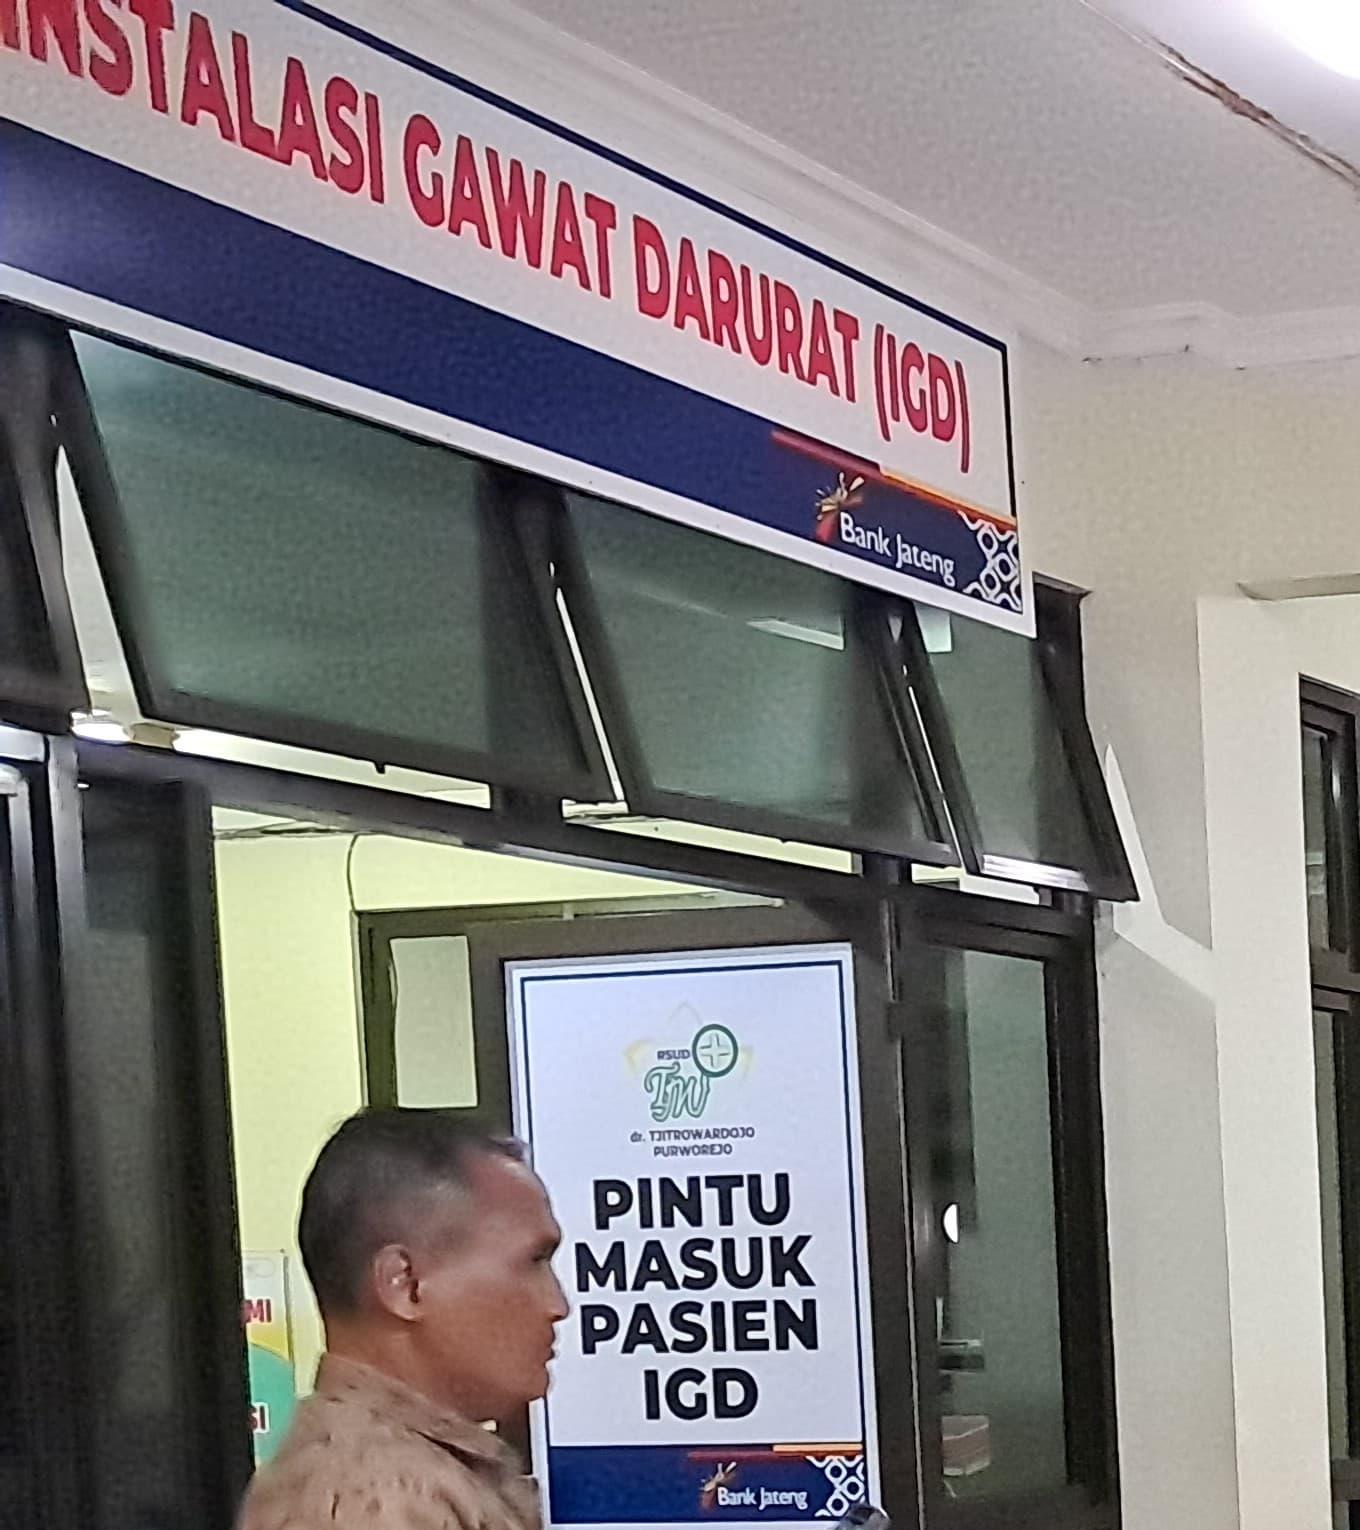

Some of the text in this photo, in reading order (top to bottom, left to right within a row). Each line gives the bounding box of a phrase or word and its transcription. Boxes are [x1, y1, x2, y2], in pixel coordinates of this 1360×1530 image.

[403, 113, 617, 299] GAWAT
[632, 214, 860, 403] DARURAT
[873, 323, 970, 474] (IGD)
[840, 511, 956, 587] Bank Jateng
[657, 1049, 691, 1061] RSUD
[649, 1127, 755, 1142] TJITROWARDOJO
[653, 1144, 733, 1157] PURWOREJO
[593, 1172, 791, 1231] PINTU
[574, 1234, 815, 1293] MASUK
[580, 1298, 819, 1355] PASIEN
[643, 1367, 759, 1421] IGD
[717, 1486, 808, 1511] Bank Jateng
